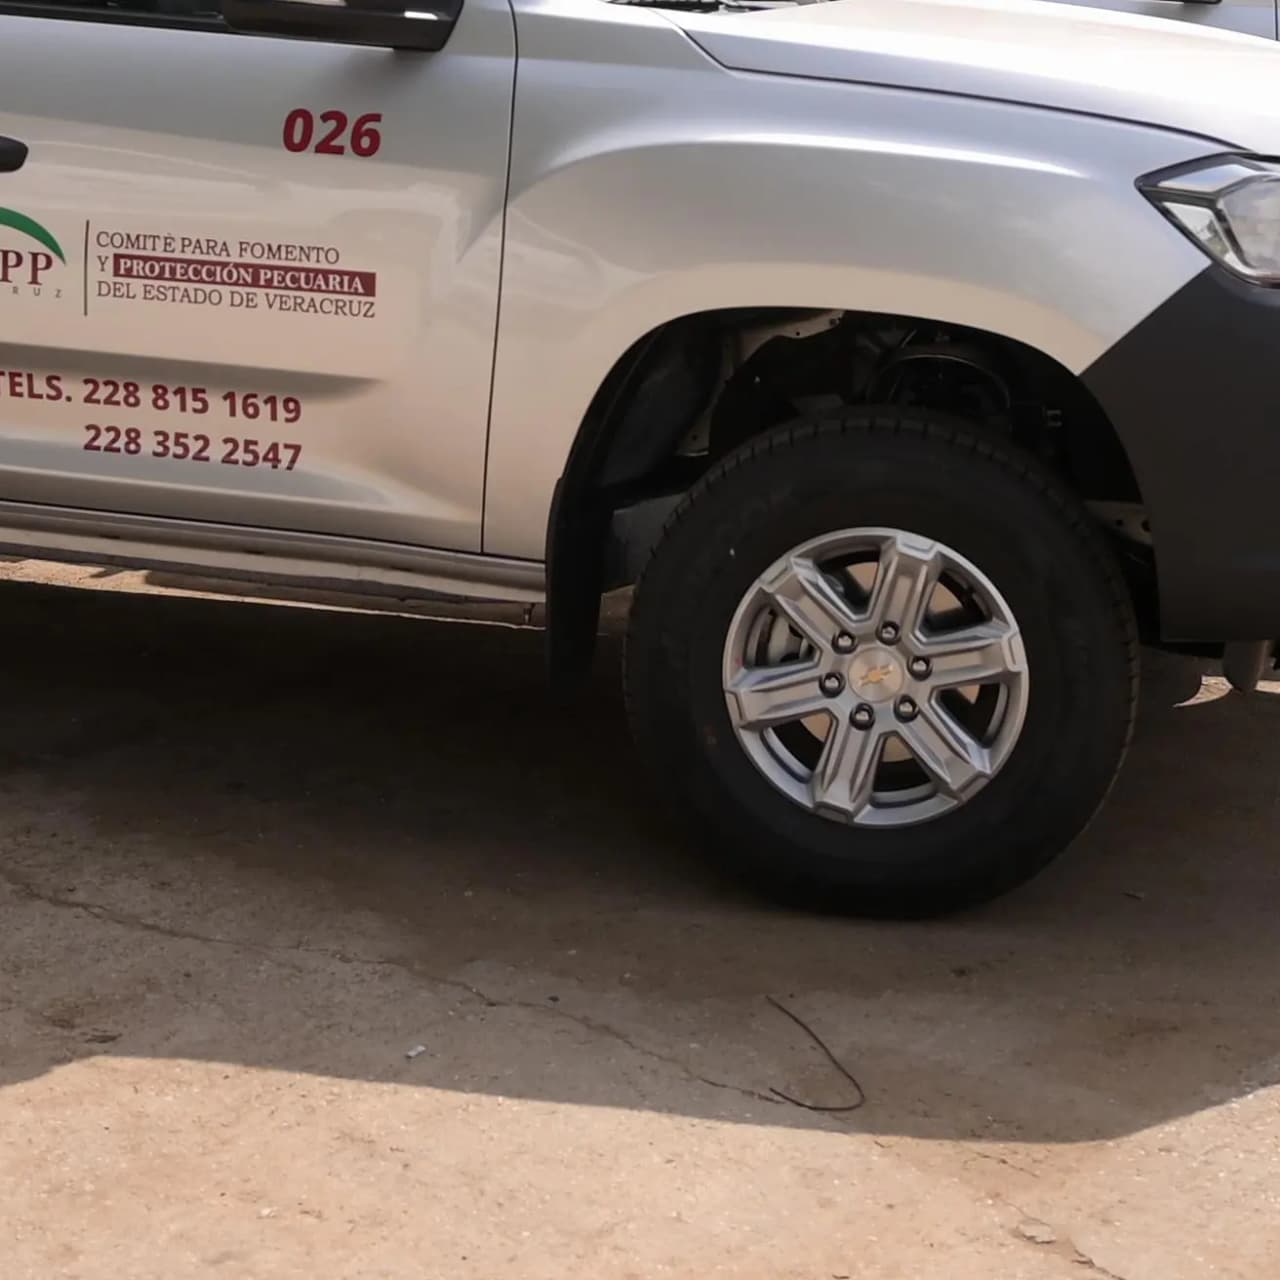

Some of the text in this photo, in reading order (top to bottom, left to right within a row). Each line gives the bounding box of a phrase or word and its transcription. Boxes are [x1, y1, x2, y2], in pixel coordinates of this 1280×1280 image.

[283, 108, 383, 157] 026
[181, 237, 231, 258] PARA
[239, 241, 340, 265] FOMENTO
[97, 255, 365, 293] Y PROTECCIÓN PECUARIA
[97, 281, 376, 318] DEL ESTADO DE VERACRUZ
[83, 377, 141, 407] 228
[151, 384, 209, 414] 815
[222, 391, 302, 423] 1619
[83, 423, 302, 471] 228 352 2547
